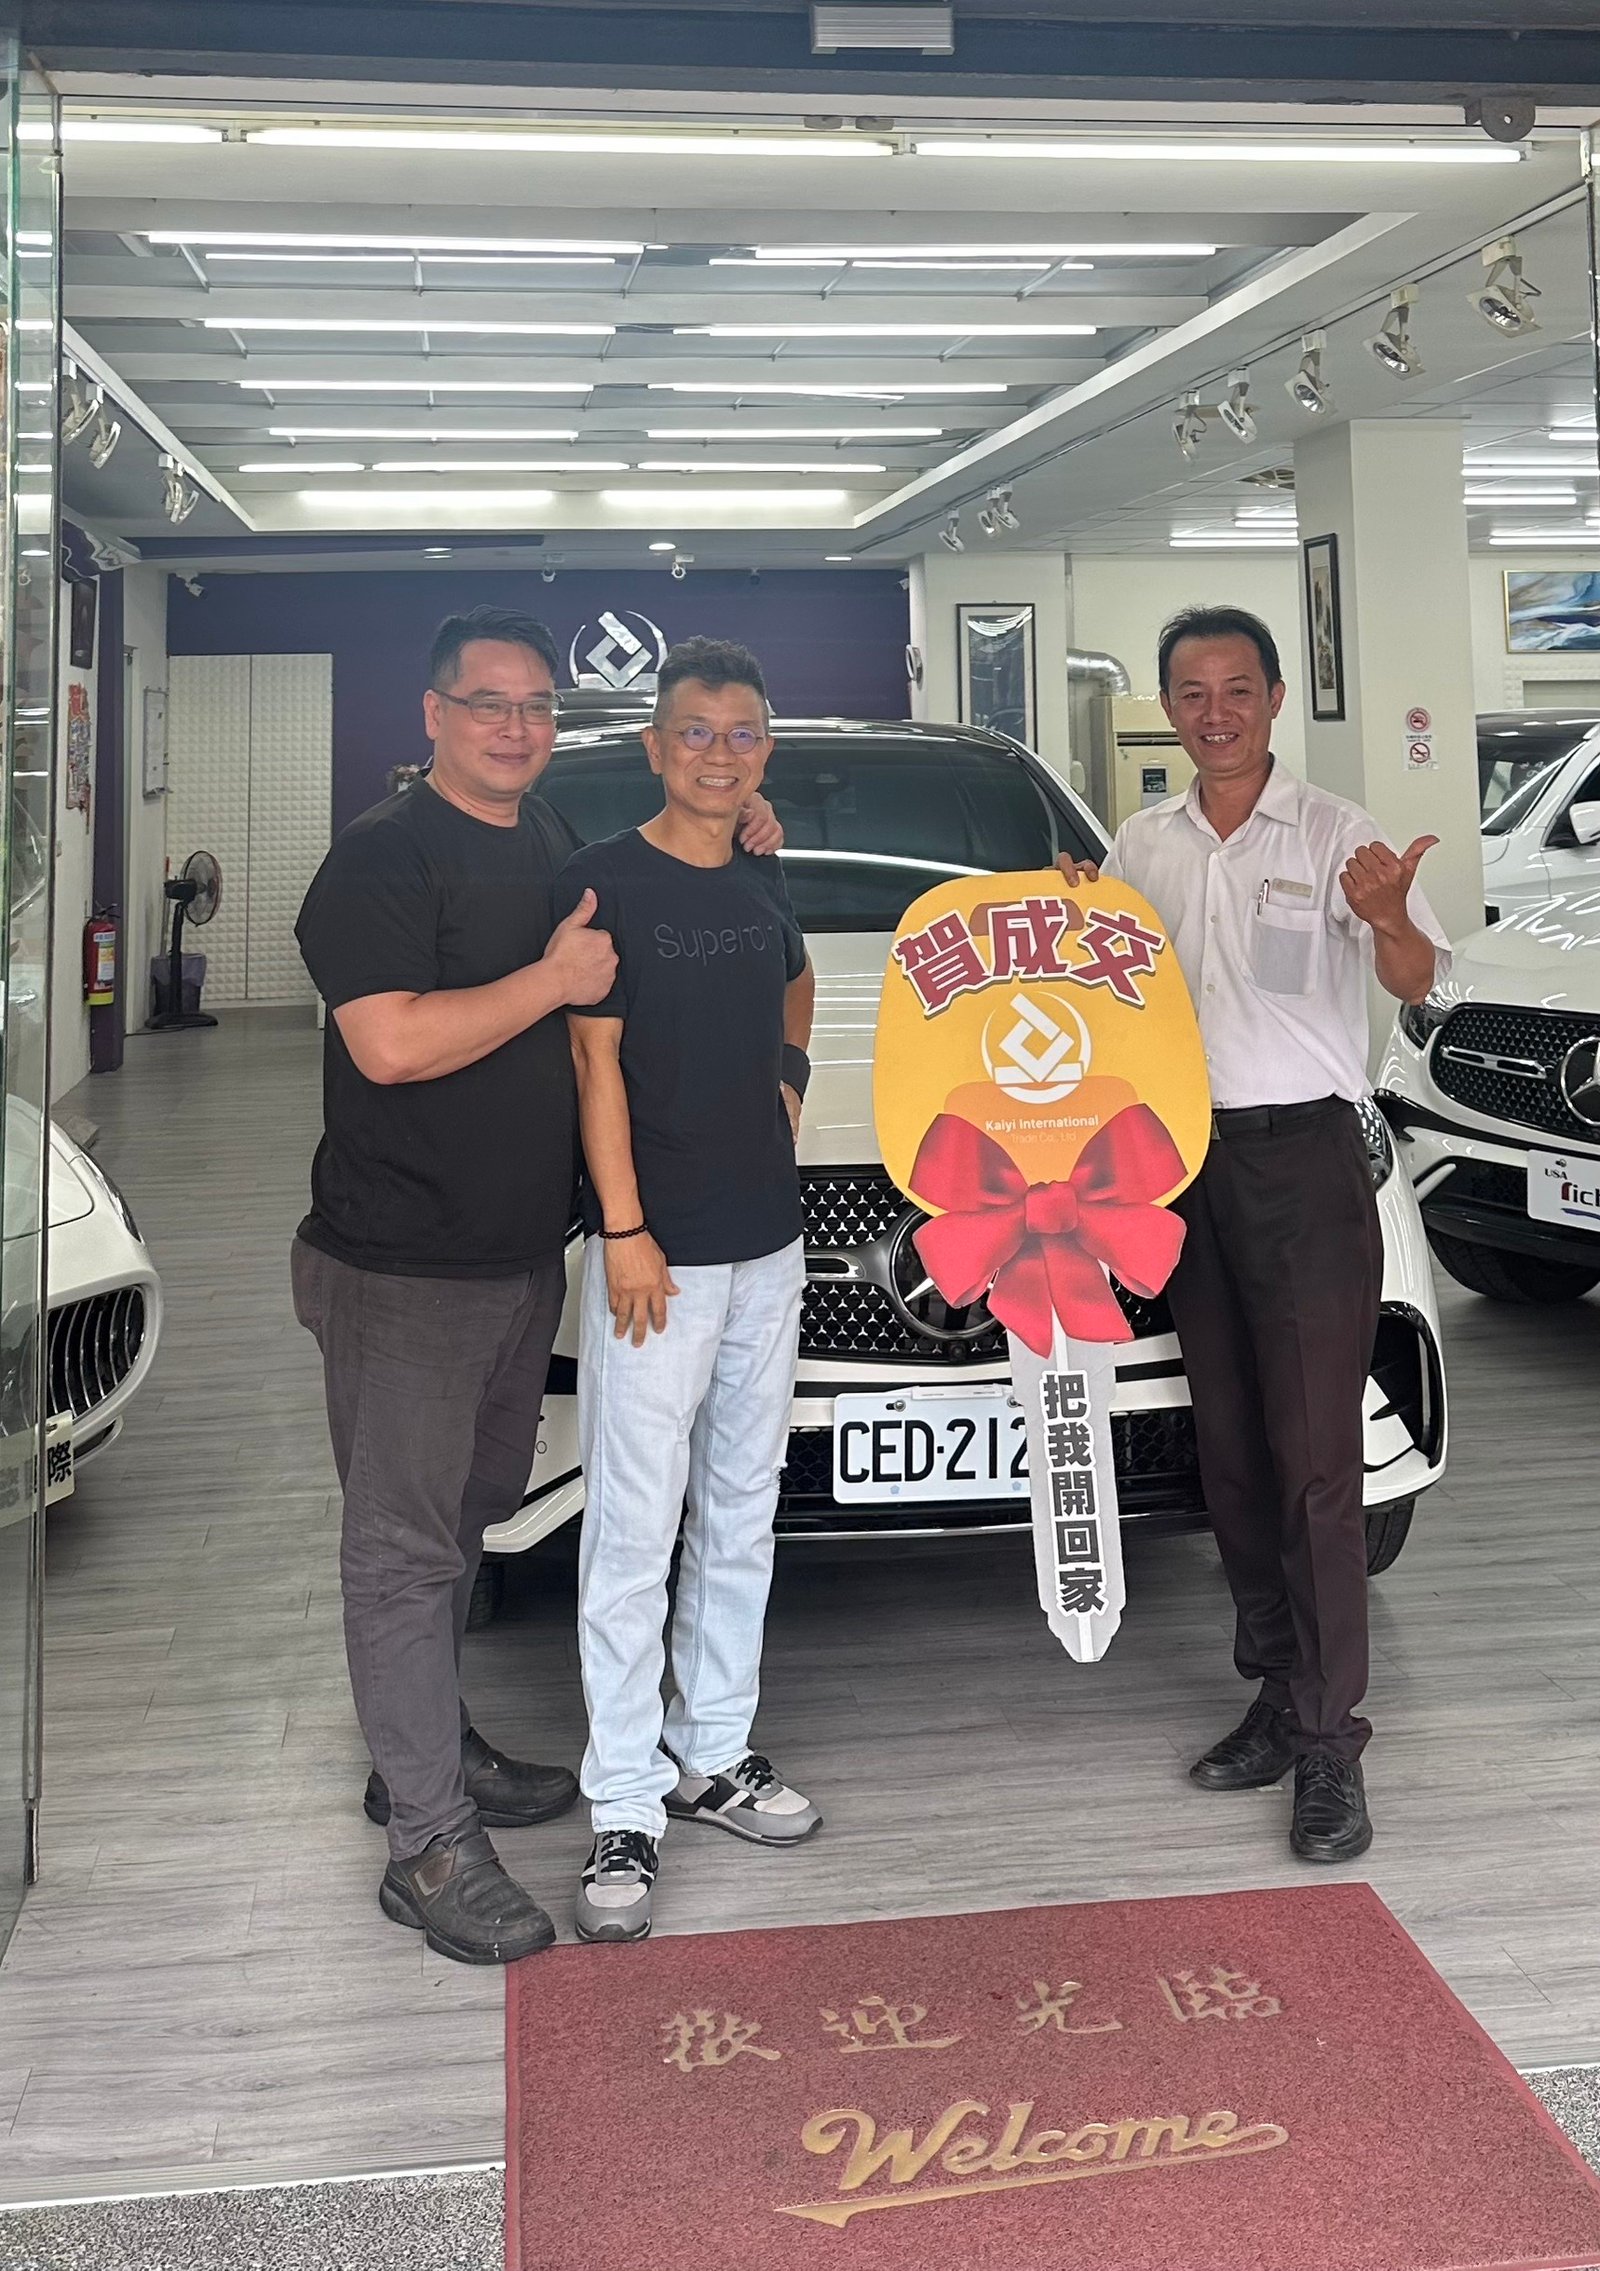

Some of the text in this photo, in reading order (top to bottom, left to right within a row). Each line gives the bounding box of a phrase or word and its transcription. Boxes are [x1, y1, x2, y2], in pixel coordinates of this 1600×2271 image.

[893, 897, 1164, 1013] 賀成交
[985, 1114, 1099, 1133] Kaiyi International
[1544, 1167, 1568, 1181] USA
[1042, 1373, 1107, 1614] 把我開回家
[800, 2099, 1289, 2197] Welcome
